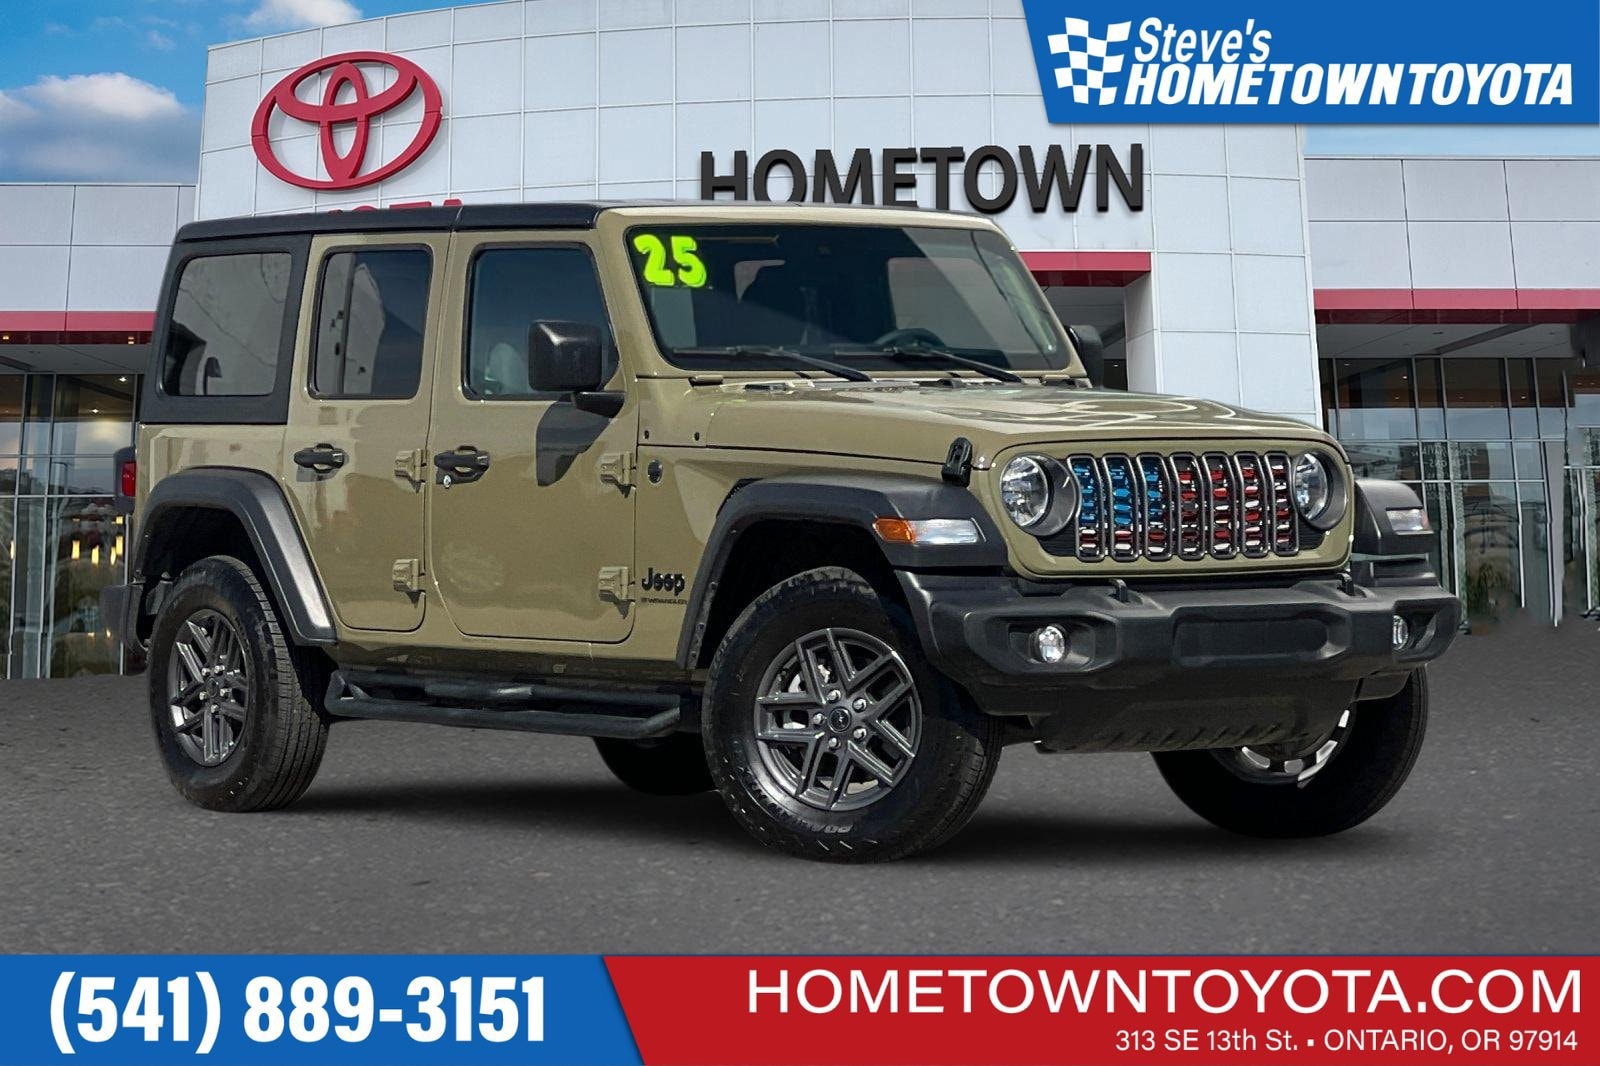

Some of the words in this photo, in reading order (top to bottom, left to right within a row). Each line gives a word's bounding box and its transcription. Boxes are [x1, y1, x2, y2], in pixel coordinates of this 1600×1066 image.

[699, 143, 1144, 213] HOMETOWN
[633, 233, 707, 288] 25
[641, 567, 686, 596] Jeep
